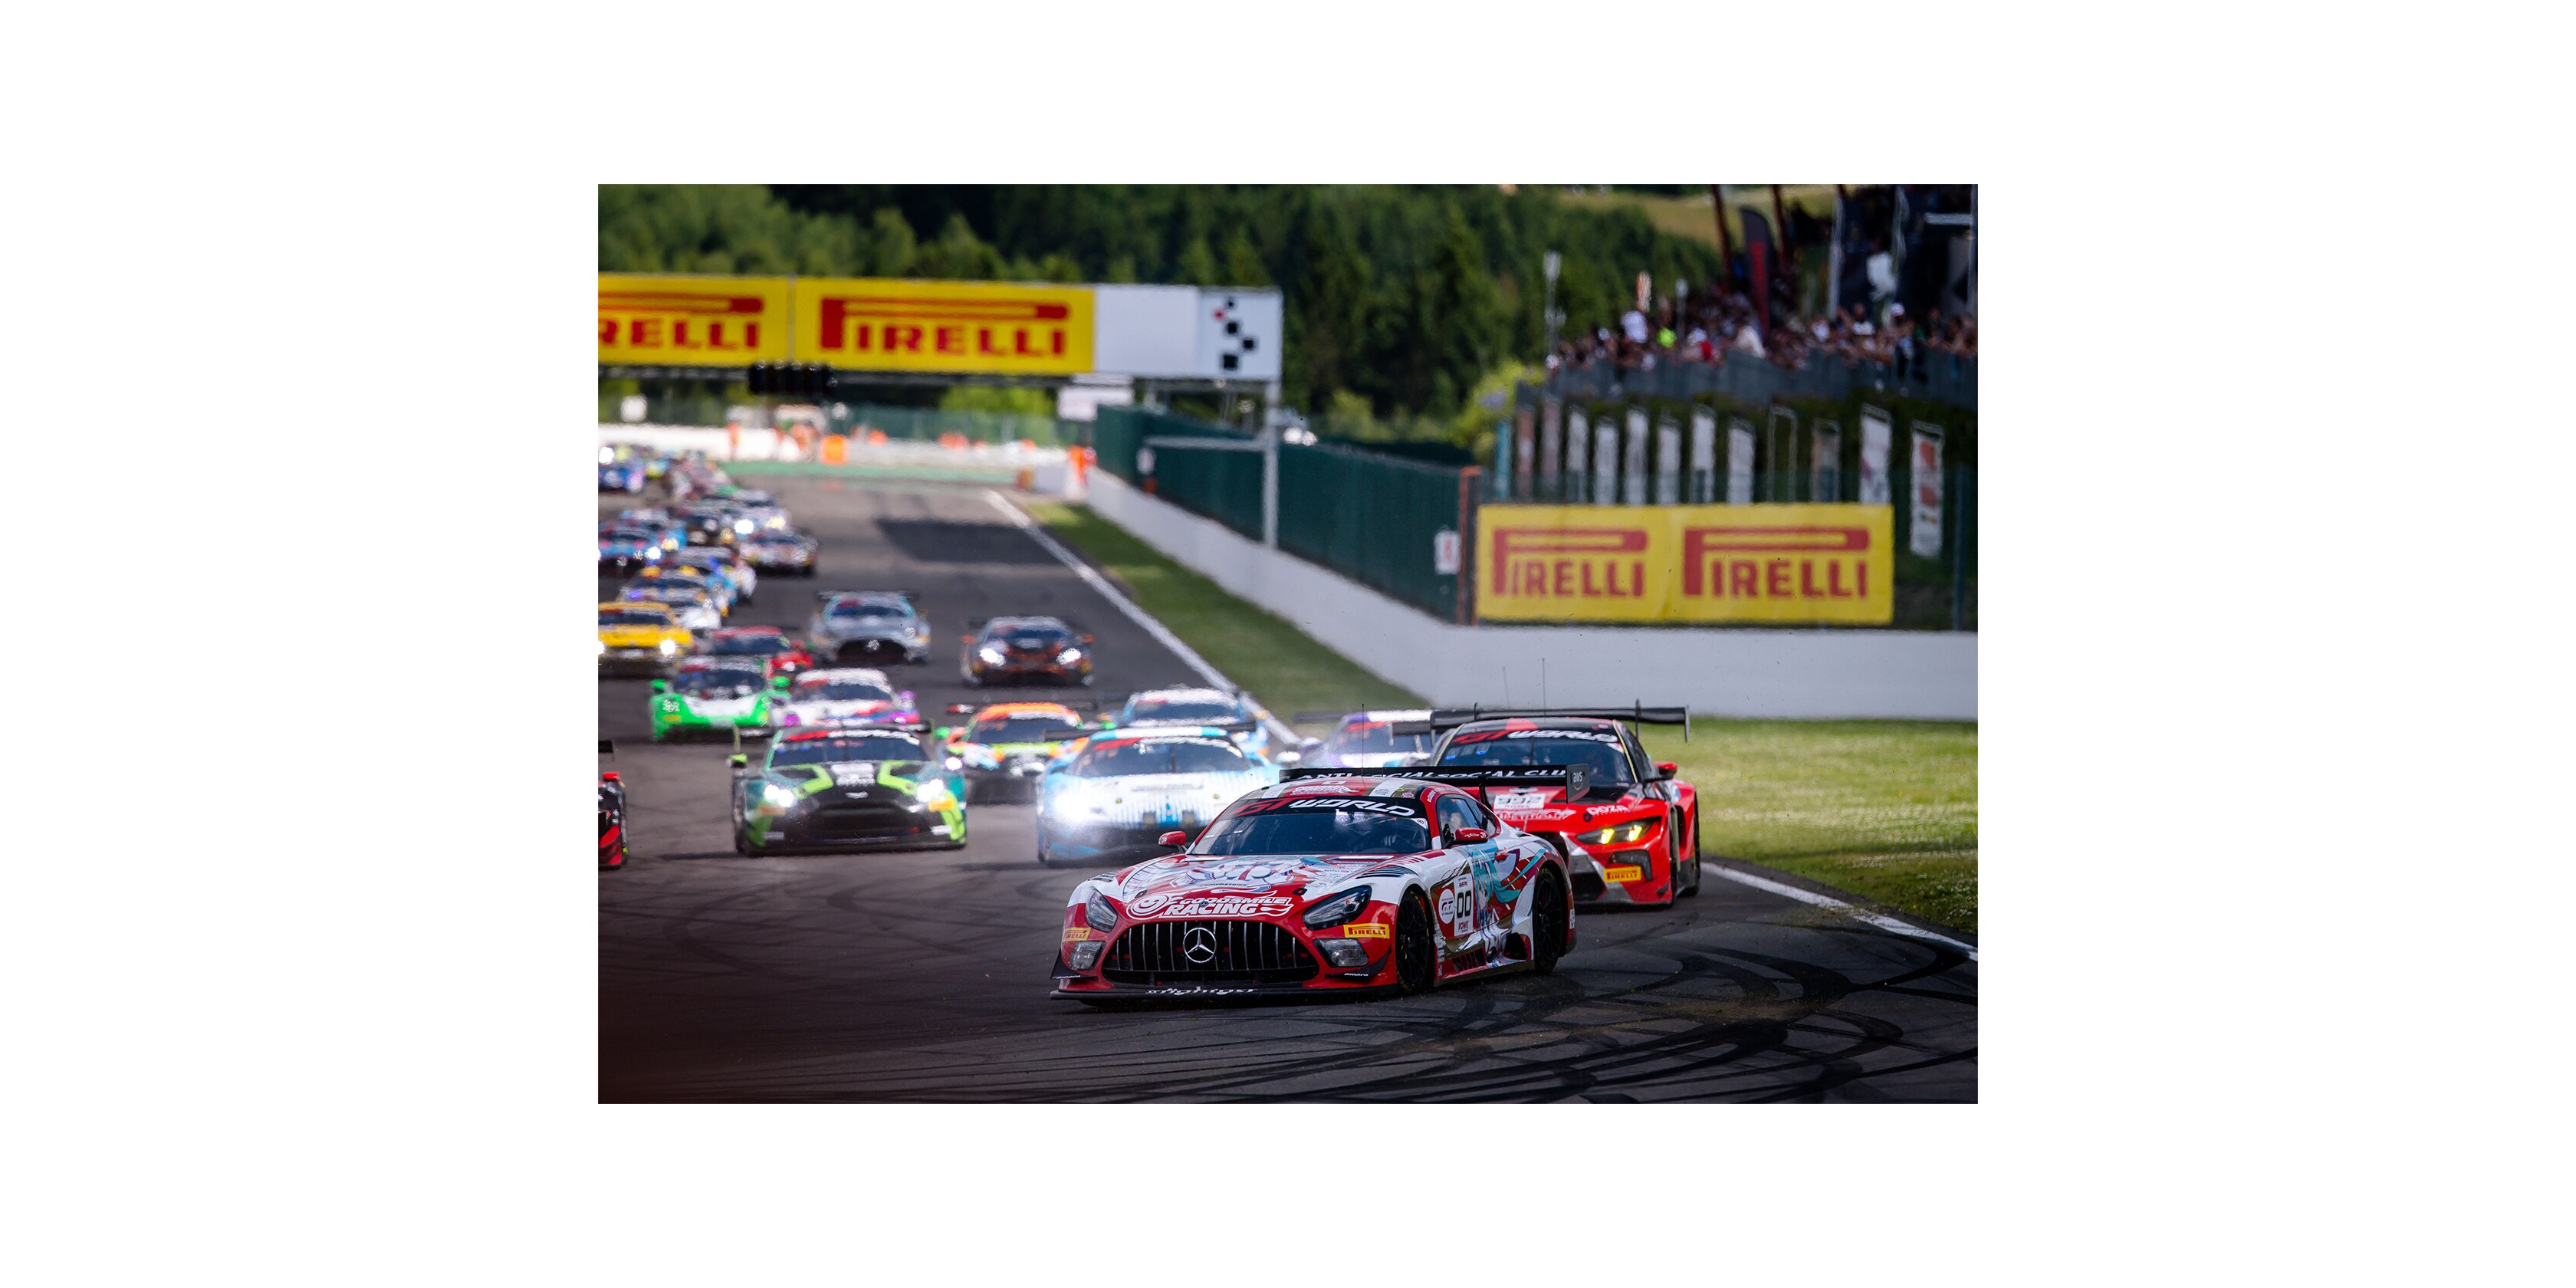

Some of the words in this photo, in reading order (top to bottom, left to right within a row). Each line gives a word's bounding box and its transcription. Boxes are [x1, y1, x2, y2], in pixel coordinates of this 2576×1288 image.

[819, 296, 1068, 356] PIRELLI
[1492, 527, 1648, 597] PIRELLI
[1684, 526, 1871, 598] PIRELLI
[1507, 730, 1618, 743] WORLD
[1289, 799, 1415, 816] WORLD
[1606, 869, 1638, 881] PIRELLI
[1163, 902, 1260, 916] RACING
[1457, 890, 1472, 918] 00
[1063, 929, 1088, 939] PIRELLI
[1347, 925, 1386, 935] PIRELLI
